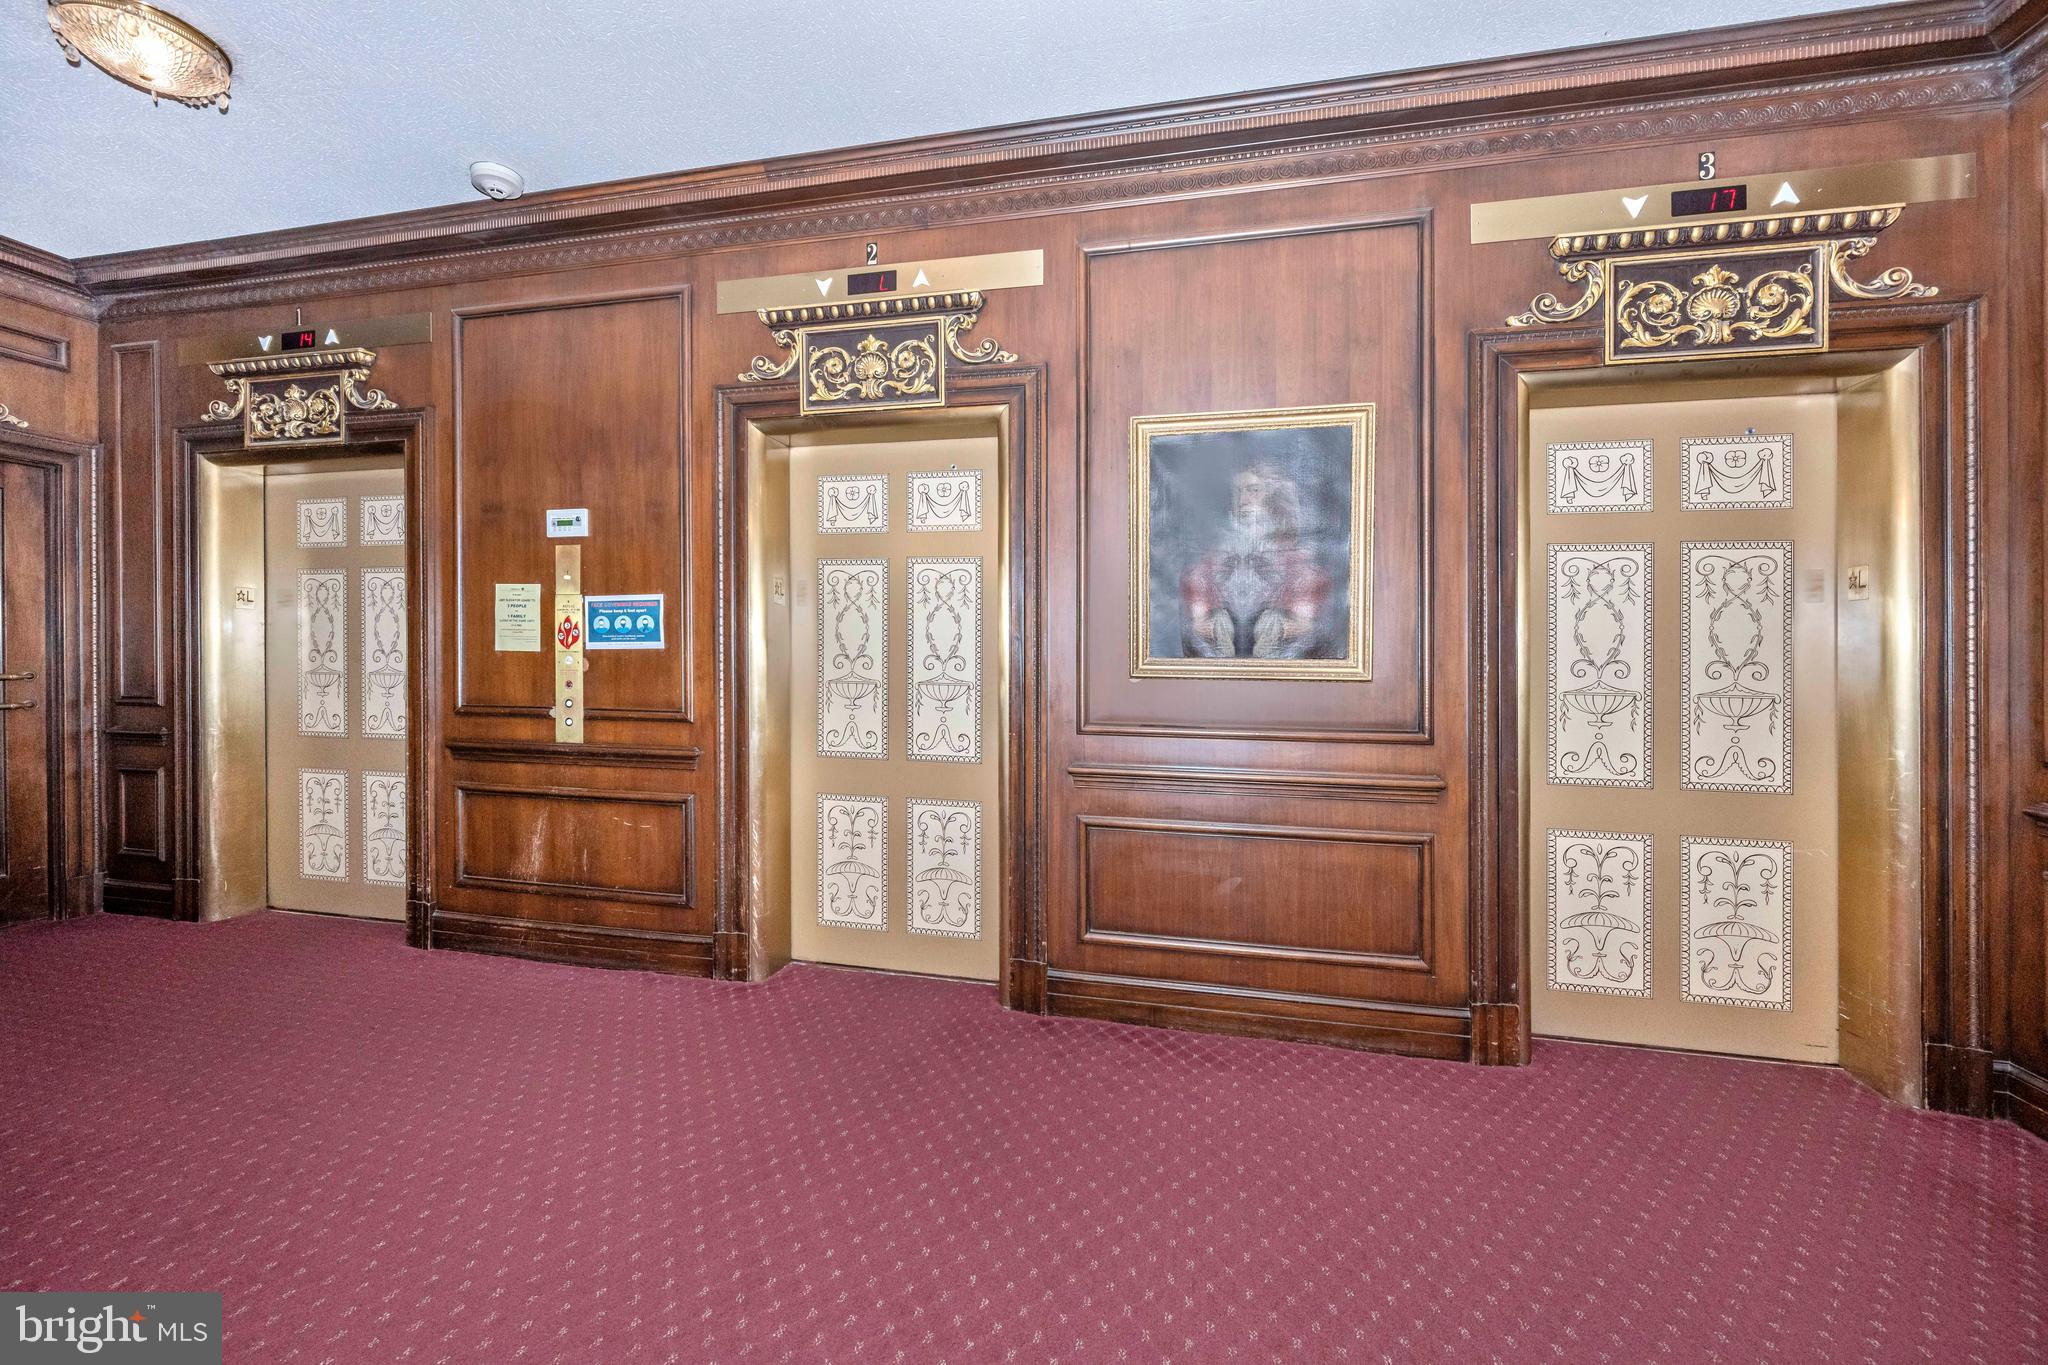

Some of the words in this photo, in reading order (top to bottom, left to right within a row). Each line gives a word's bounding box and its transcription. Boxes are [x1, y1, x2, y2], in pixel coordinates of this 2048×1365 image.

[1699, 152, 1716, 180] 3
[1709, 189, 1737, 211] 17
[866, 243, 878, 266] 2
[879, 272, 889, 291] L
[296, 308, 302, 326] 1
[299, 333, 313, 348] 14
[246, 590, 255, 603] L
